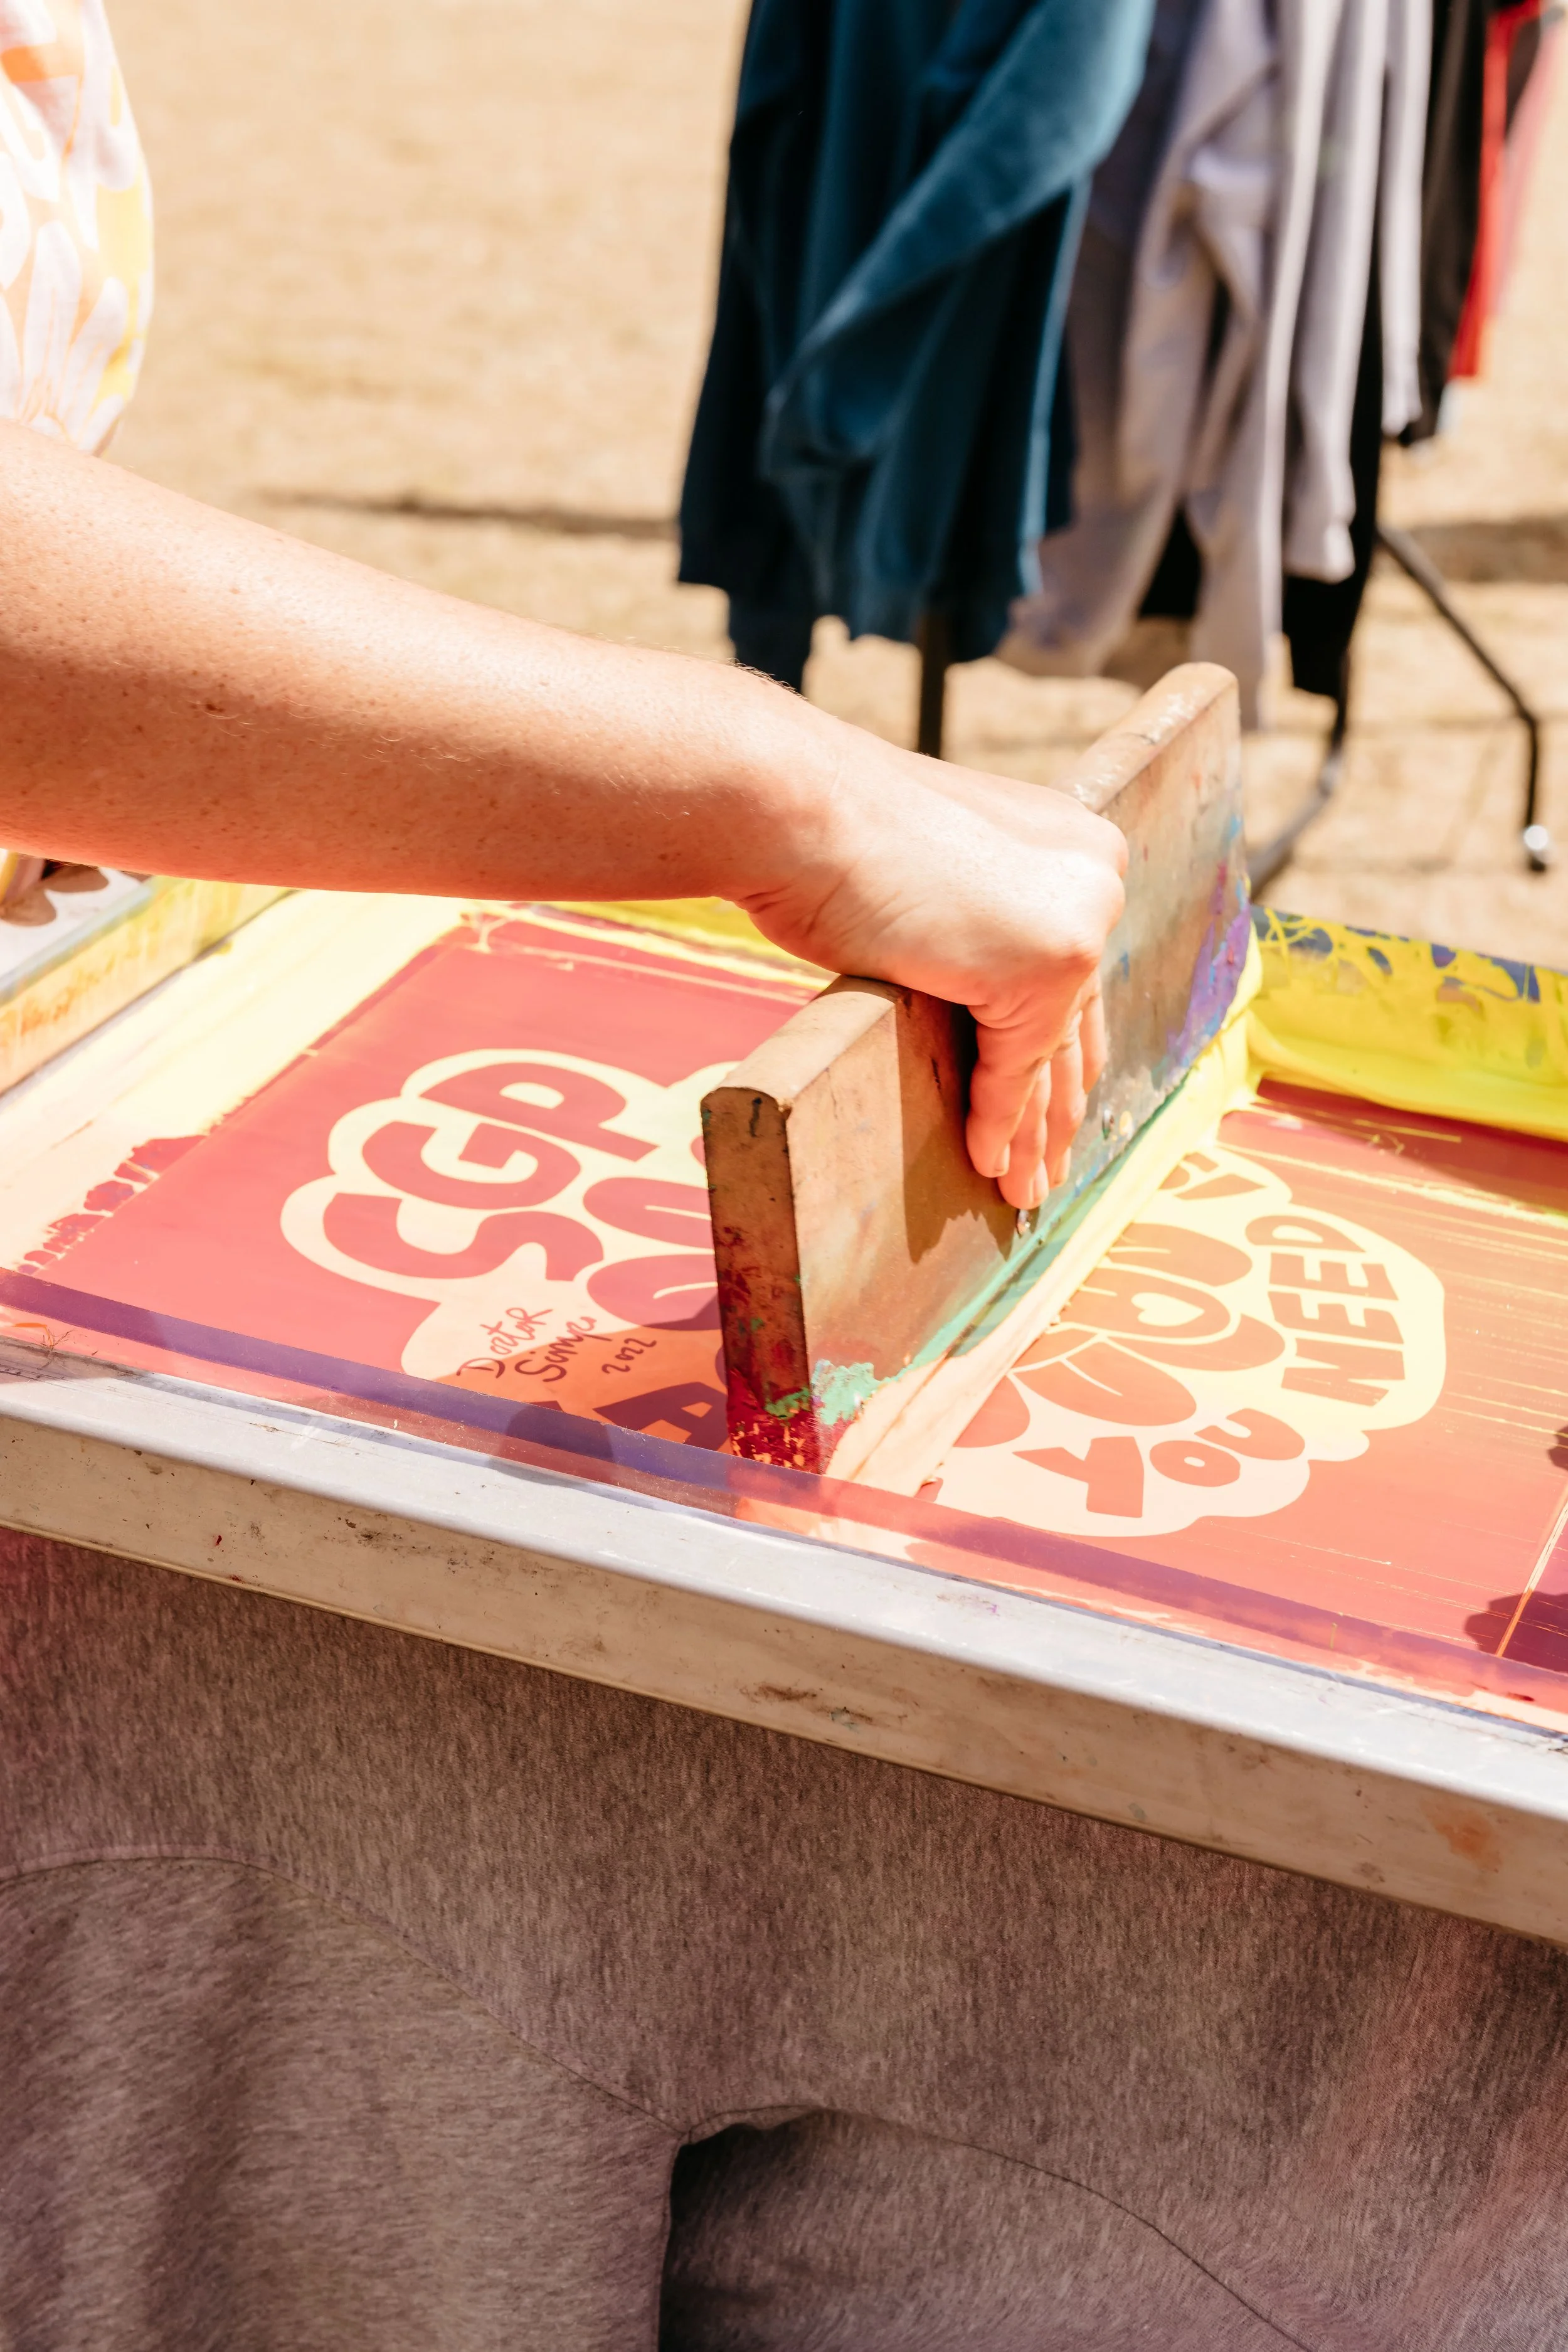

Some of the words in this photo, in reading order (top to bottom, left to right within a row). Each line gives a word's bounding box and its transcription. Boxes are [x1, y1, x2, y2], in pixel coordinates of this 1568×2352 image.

[322, 1062, 662, 1283] SGP
[601, 1337, 657, 1375] 2022
[1011, 1407, 1306, 1518] YOU
[1244, 1214, 1406, 1407] NEED
